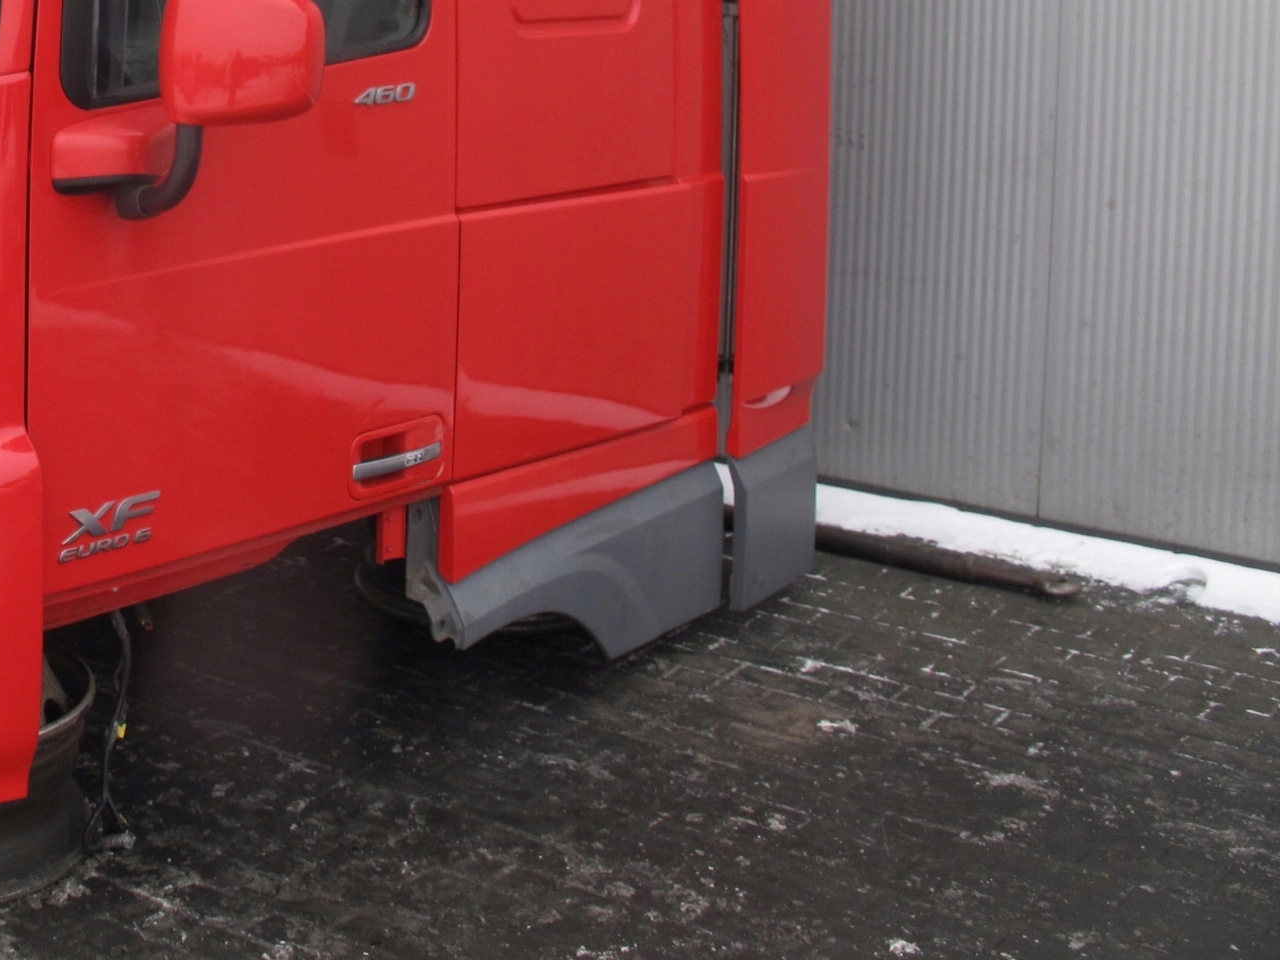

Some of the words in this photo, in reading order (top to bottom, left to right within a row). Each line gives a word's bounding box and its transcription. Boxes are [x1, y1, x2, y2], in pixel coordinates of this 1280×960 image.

[354, 82, 416, 106] 460
[61, 490, 161, 545] XF
[59, 534, 129, 562] EURO
[134, 527, 152, 543] 6
